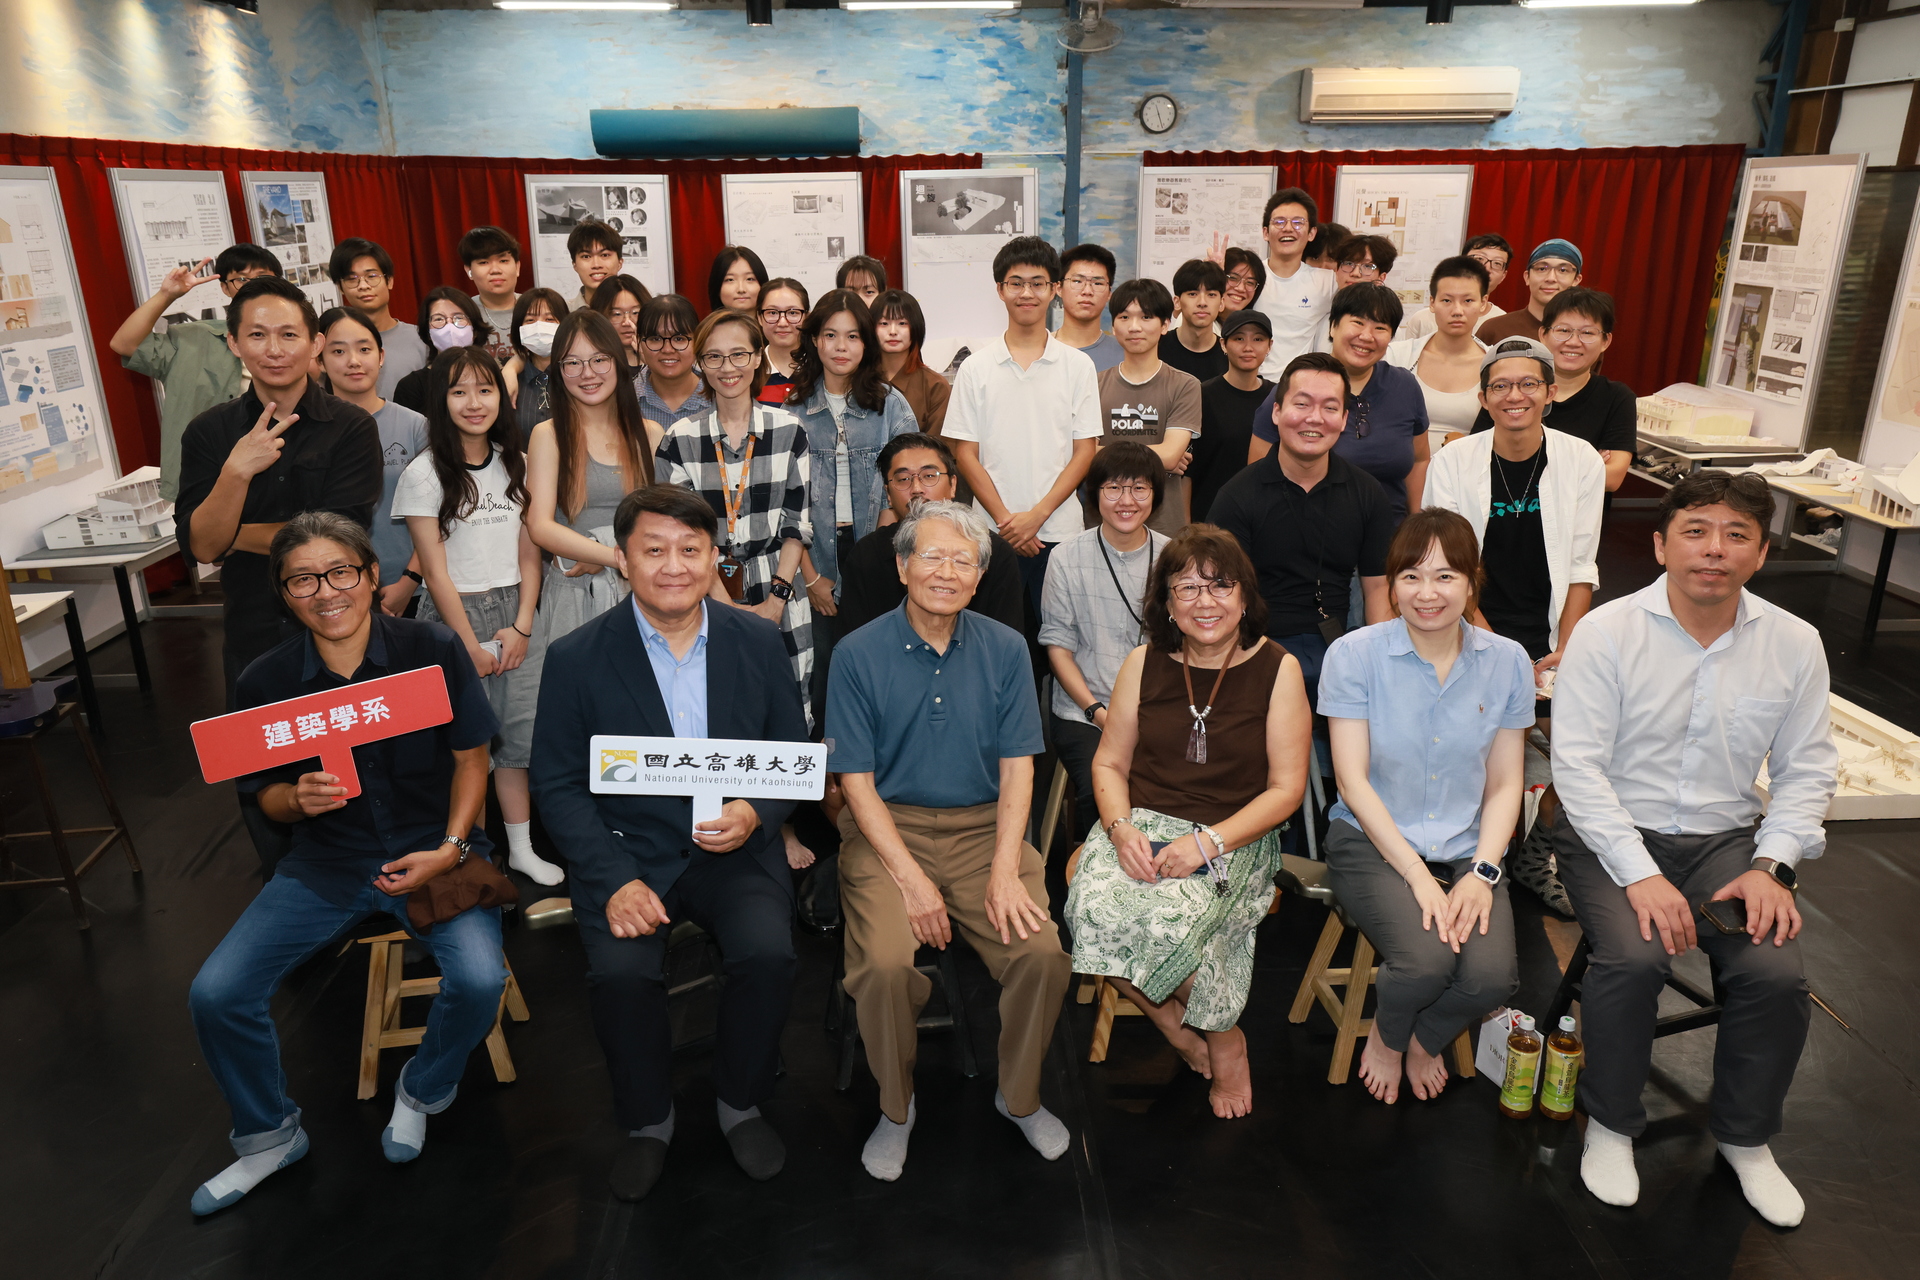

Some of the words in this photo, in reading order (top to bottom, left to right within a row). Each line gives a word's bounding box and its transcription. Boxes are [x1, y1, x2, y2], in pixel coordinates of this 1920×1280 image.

[1111, 419, 1144, 430] POLAR
[486, 492, 514, 512] Beach
[491, 515, 508, 524] SUNBATH
[262, 696, 391, 750] 建築學系
[644, 752, 816, 775] 國立高雄大學
[644, 774, 687, 782] National
[691, 775, 743, 786] University
[747, 777, 757, 785] of
[761, 777, 814, 789] Kaohsiung
